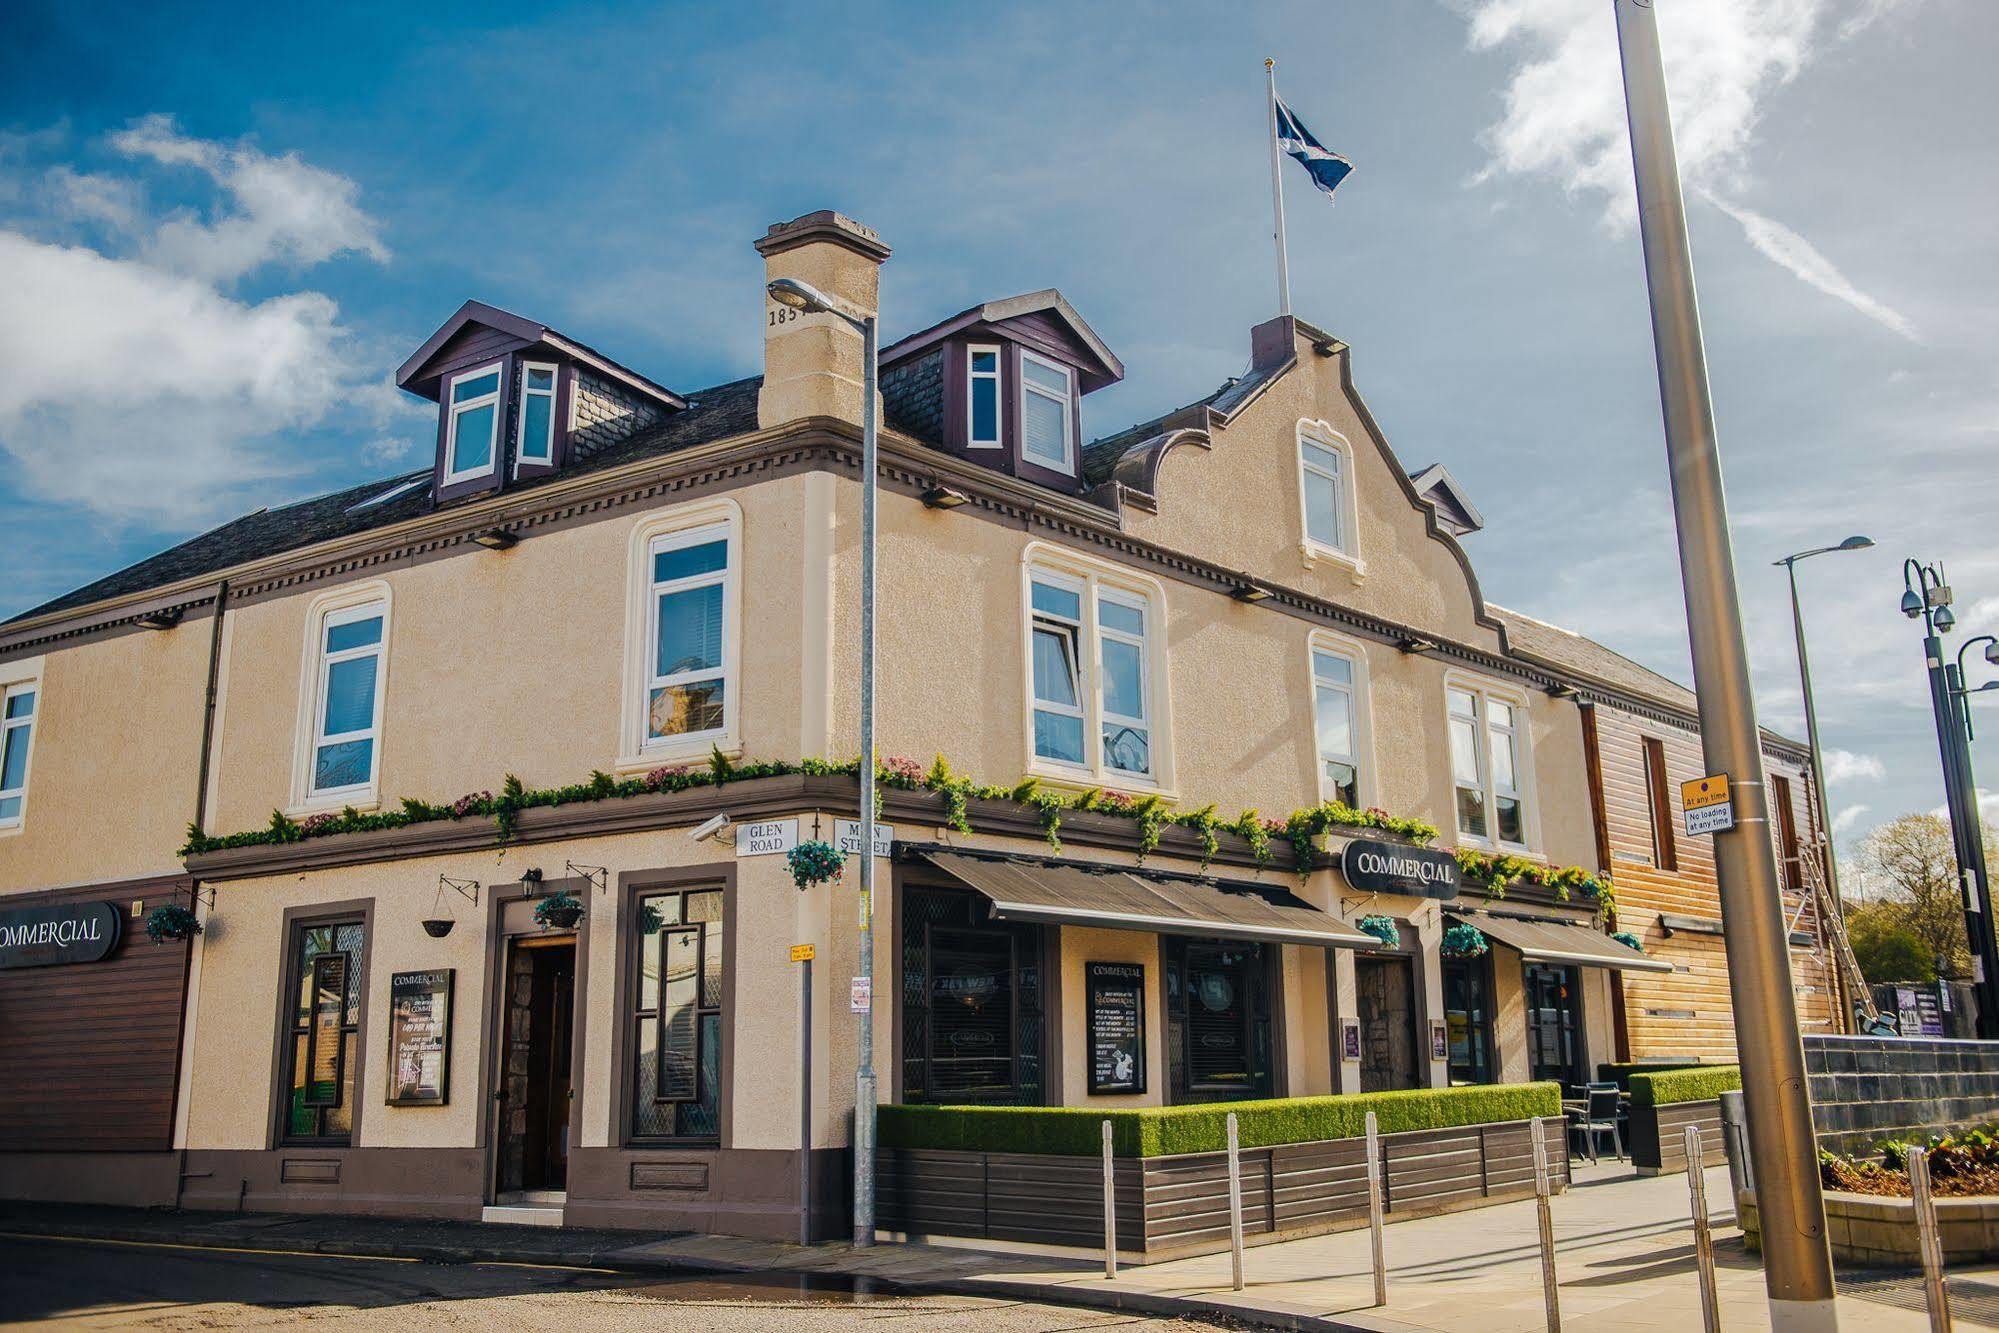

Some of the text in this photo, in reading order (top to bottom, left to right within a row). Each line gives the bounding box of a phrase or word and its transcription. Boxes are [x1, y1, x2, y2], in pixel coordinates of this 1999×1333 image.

[1686, 792, 1727, 806] At any time
[1701, 808, 1727, 818] loading
[750, 823, 783, 838] GLEN
[849, 823, 881, 837] MN
[1690, 818, 1728, 830] at any time
[750, 838, 783, 852] ROAD
[1358, 852, 1454, 885] COMMERCIAL
[1093, 965, 1141, 978] COMMERCIAL
[394, 974, 445, 986] COMMERCIAL
